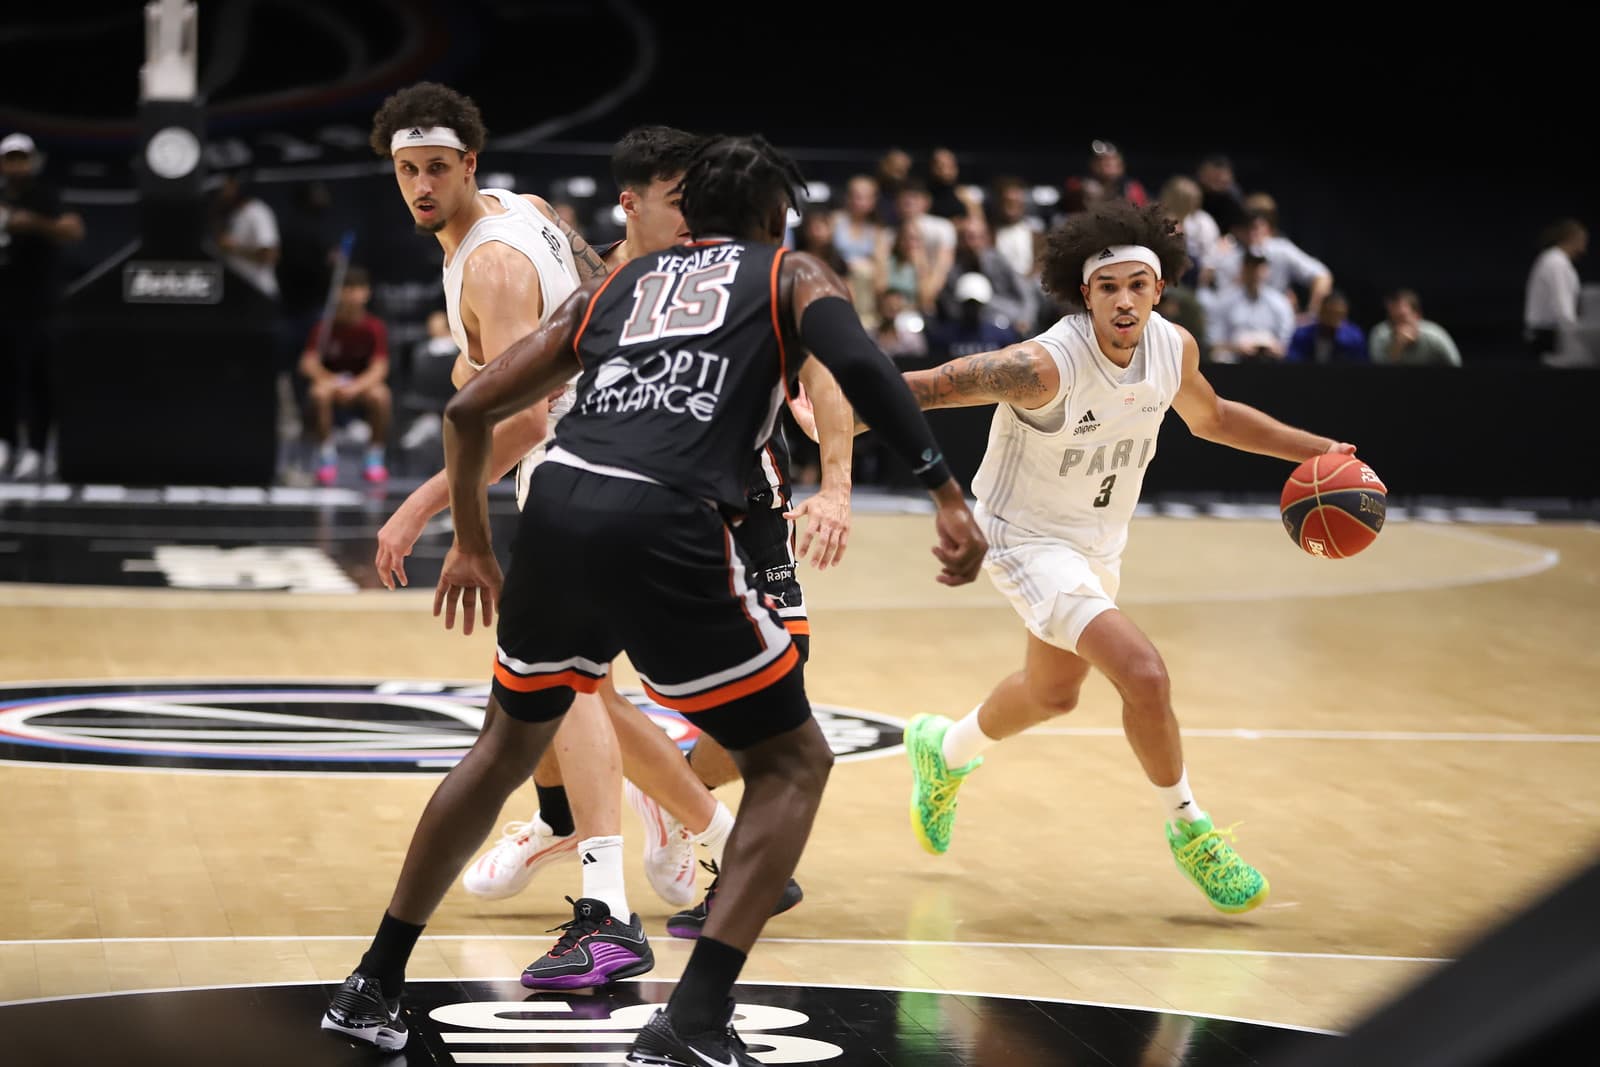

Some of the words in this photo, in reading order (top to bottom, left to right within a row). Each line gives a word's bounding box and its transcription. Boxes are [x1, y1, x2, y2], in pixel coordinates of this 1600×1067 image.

[618, 261, 740, 346] 15
[631, 350, 730, 395] OPTI
[1059, 438, 1152, 477] PARI
[1093, 473, 1117, 508] 3
